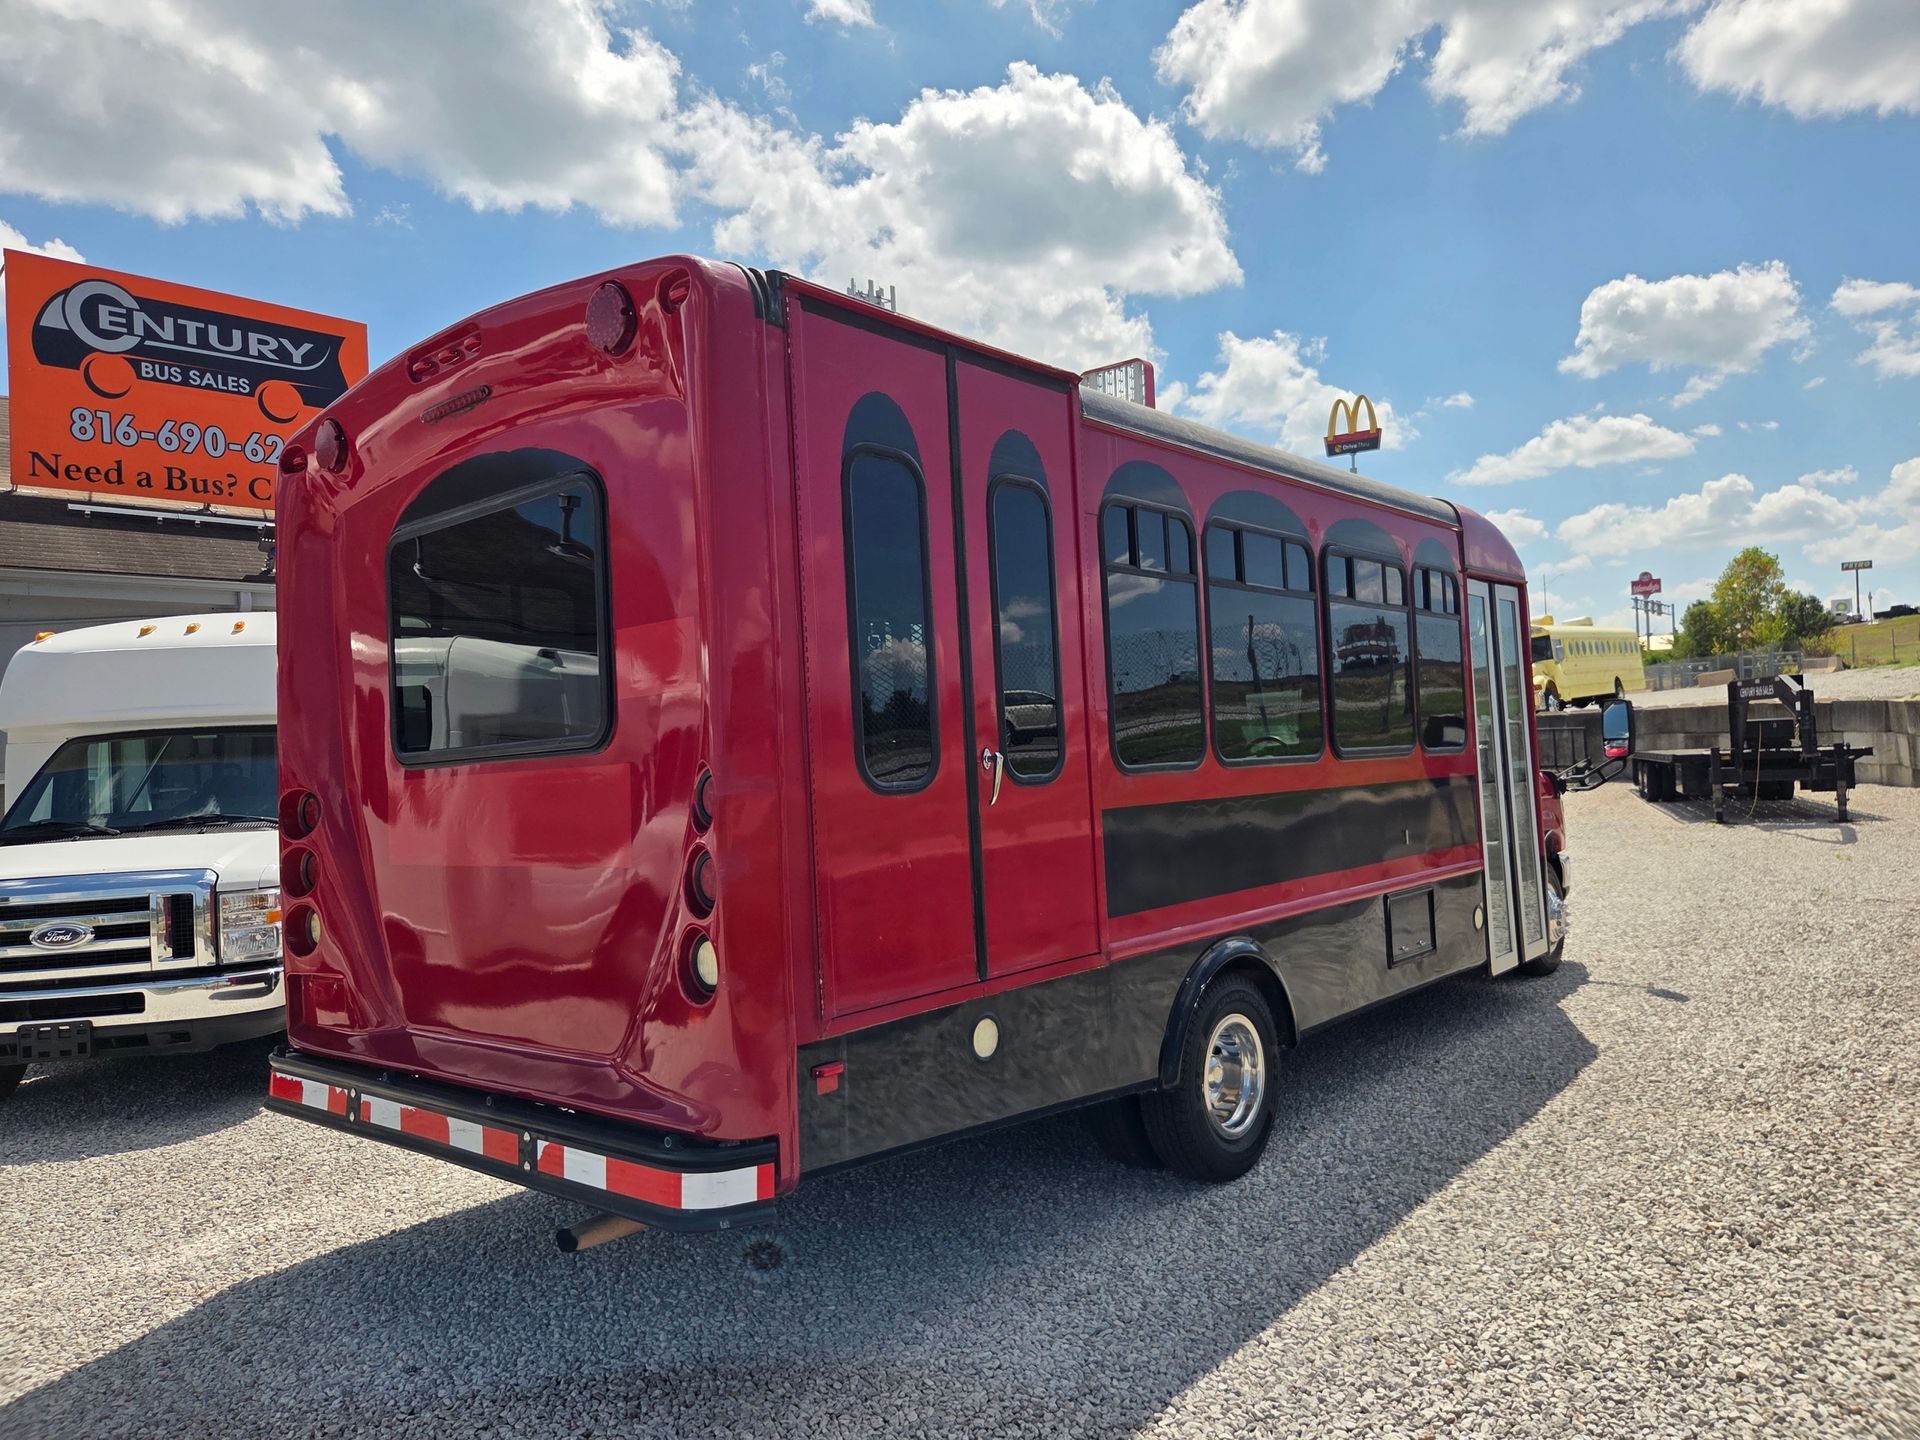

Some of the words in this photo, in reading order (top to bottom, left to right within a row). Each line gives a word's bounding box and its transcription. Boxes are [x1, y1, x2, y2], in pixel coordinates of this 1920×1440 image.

[64, 279, 314, 364] CENTURY
[141, 361, 182, 383] BUS
[189, 369, 250, 394] SALES
[70, 407, 285, 465] 816-690-62
[1342, 442, 1358, 450] Drive
[28, 451, 125, 486] Need
[137, 472, 154, 489] a
[164, 466, 238, 497] Bus?
[1843, 561, 1870, 569] PETRO
[44, 929, 72, 943] Ford
